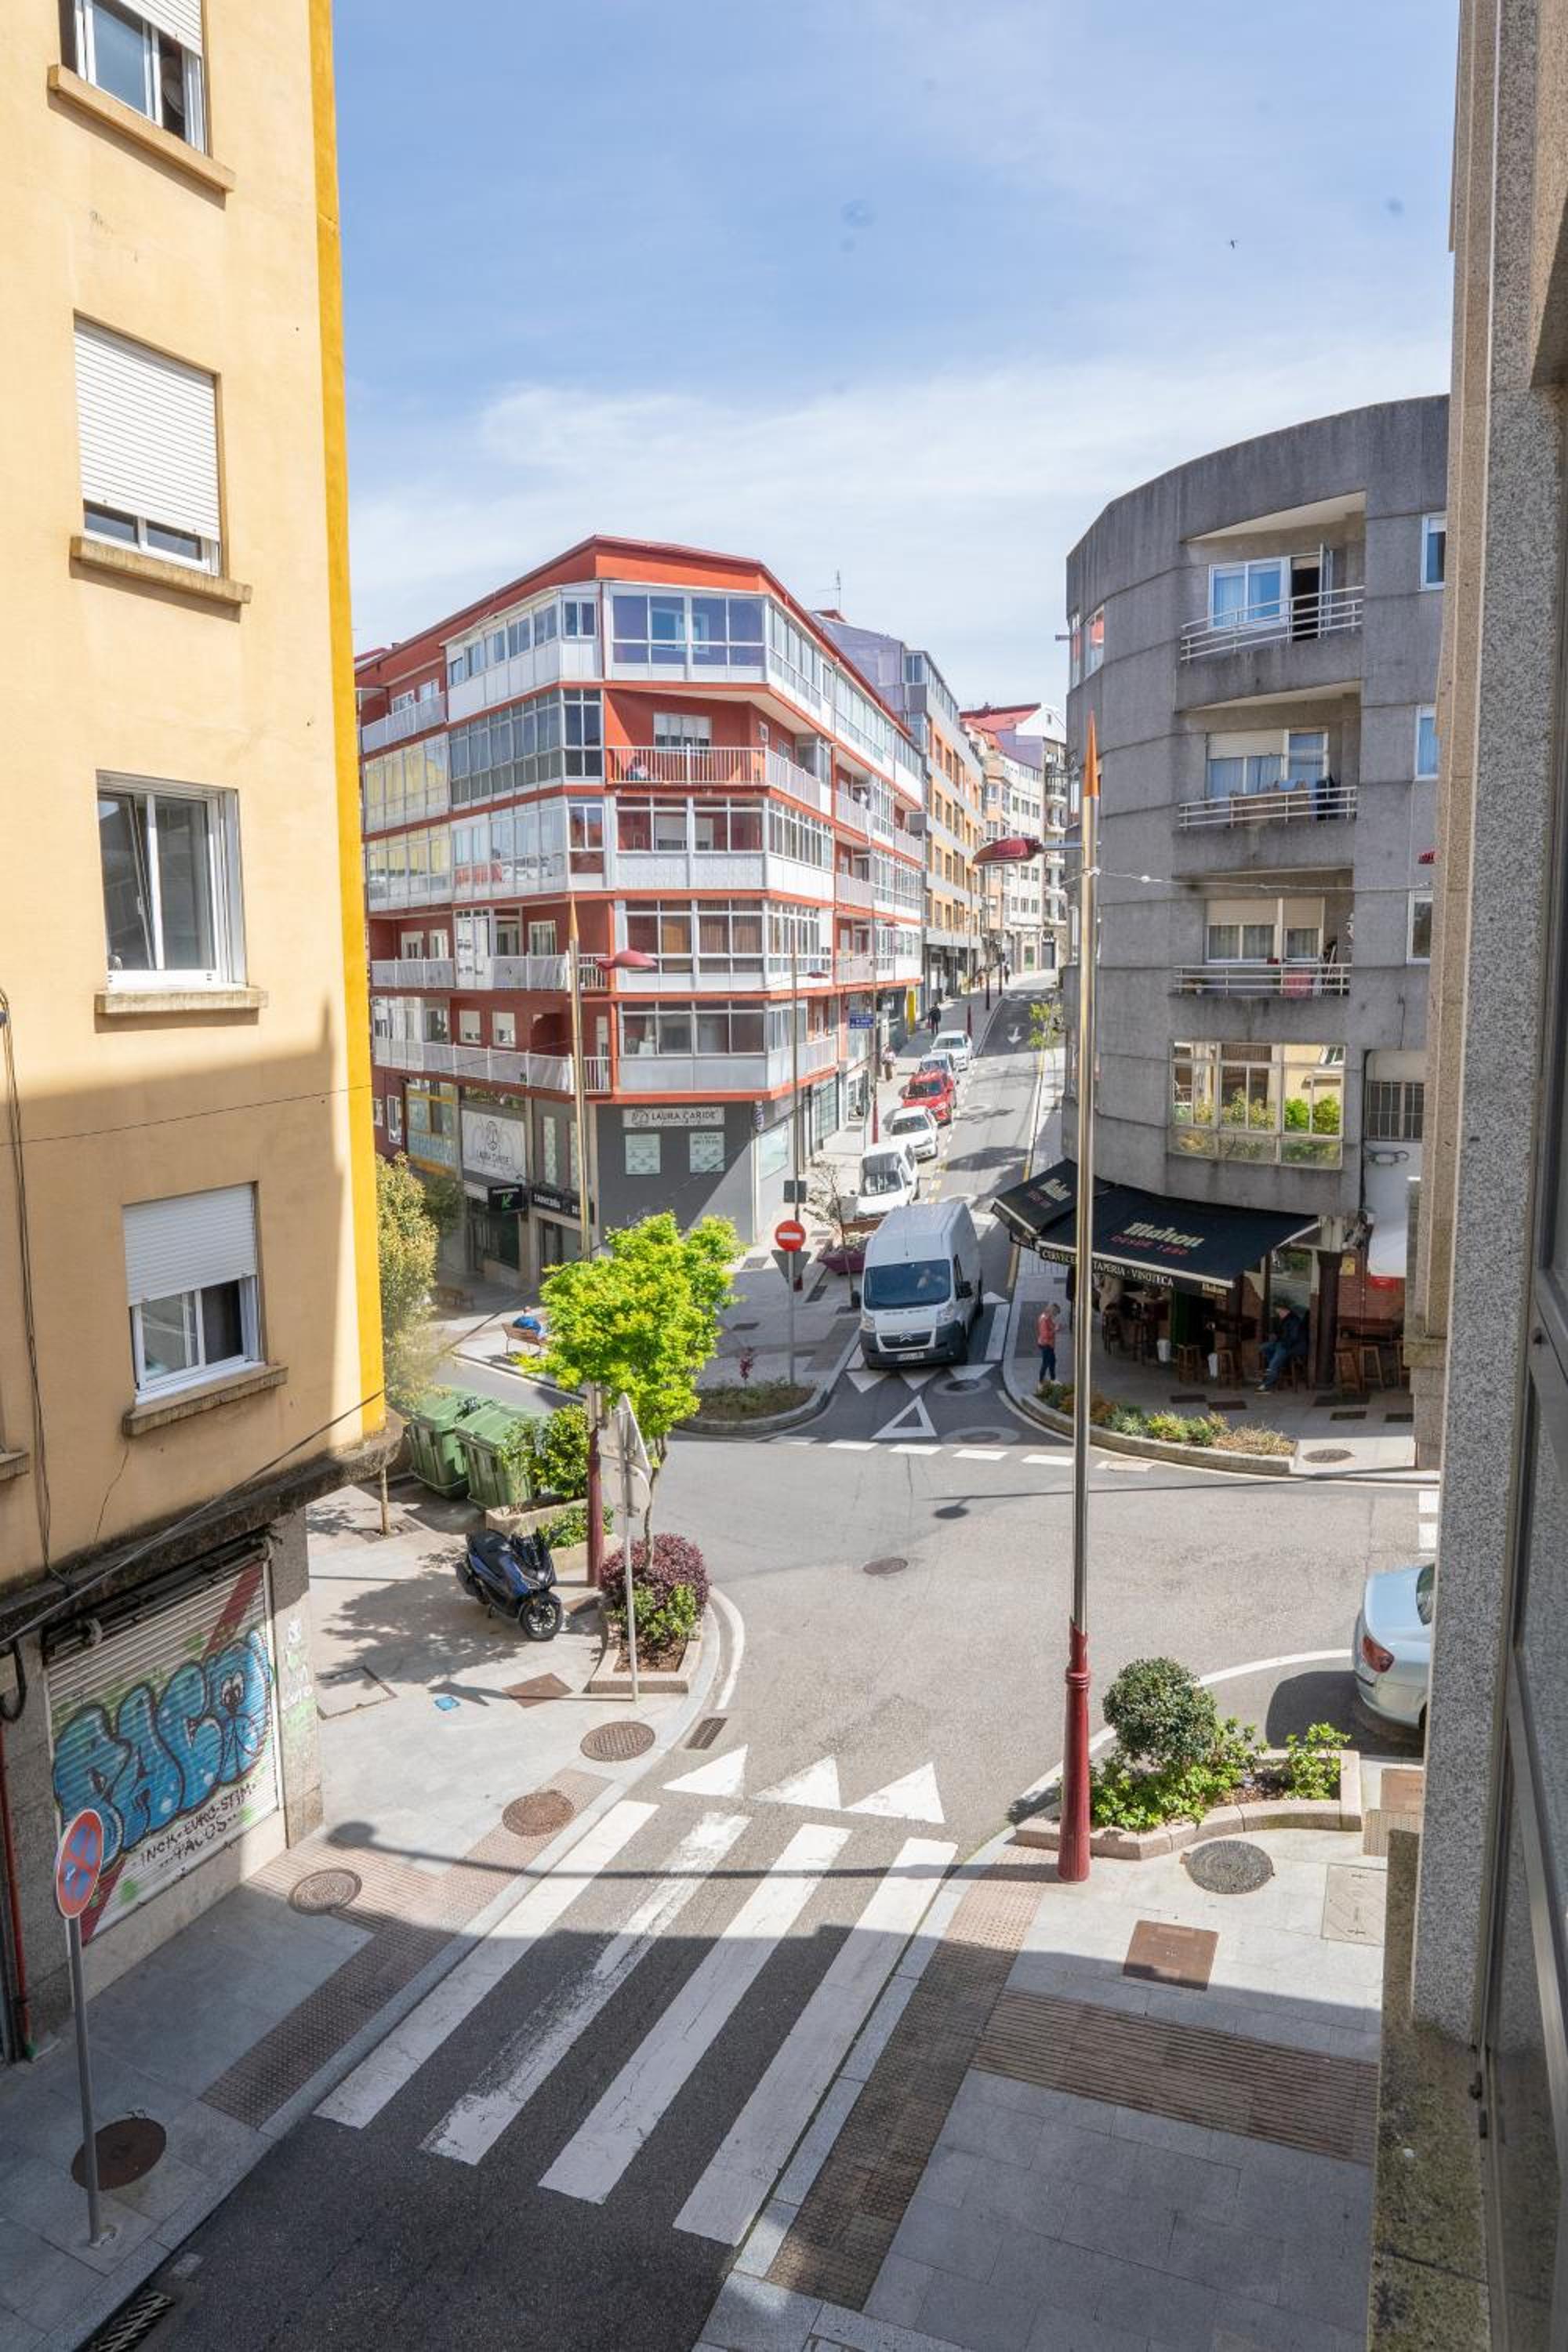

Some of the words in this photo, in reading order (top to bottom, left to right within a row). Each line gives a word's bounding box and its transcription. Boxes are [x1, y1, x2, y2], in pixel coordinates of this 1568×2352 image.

[652, 1111, 680, 1121] LAURA
[682, 1110, 717, 1121] CARIDE
[1123, 1221, 1204, 1248] Mahou
[1131, 1268, 1174, 1287] VINOTECA
